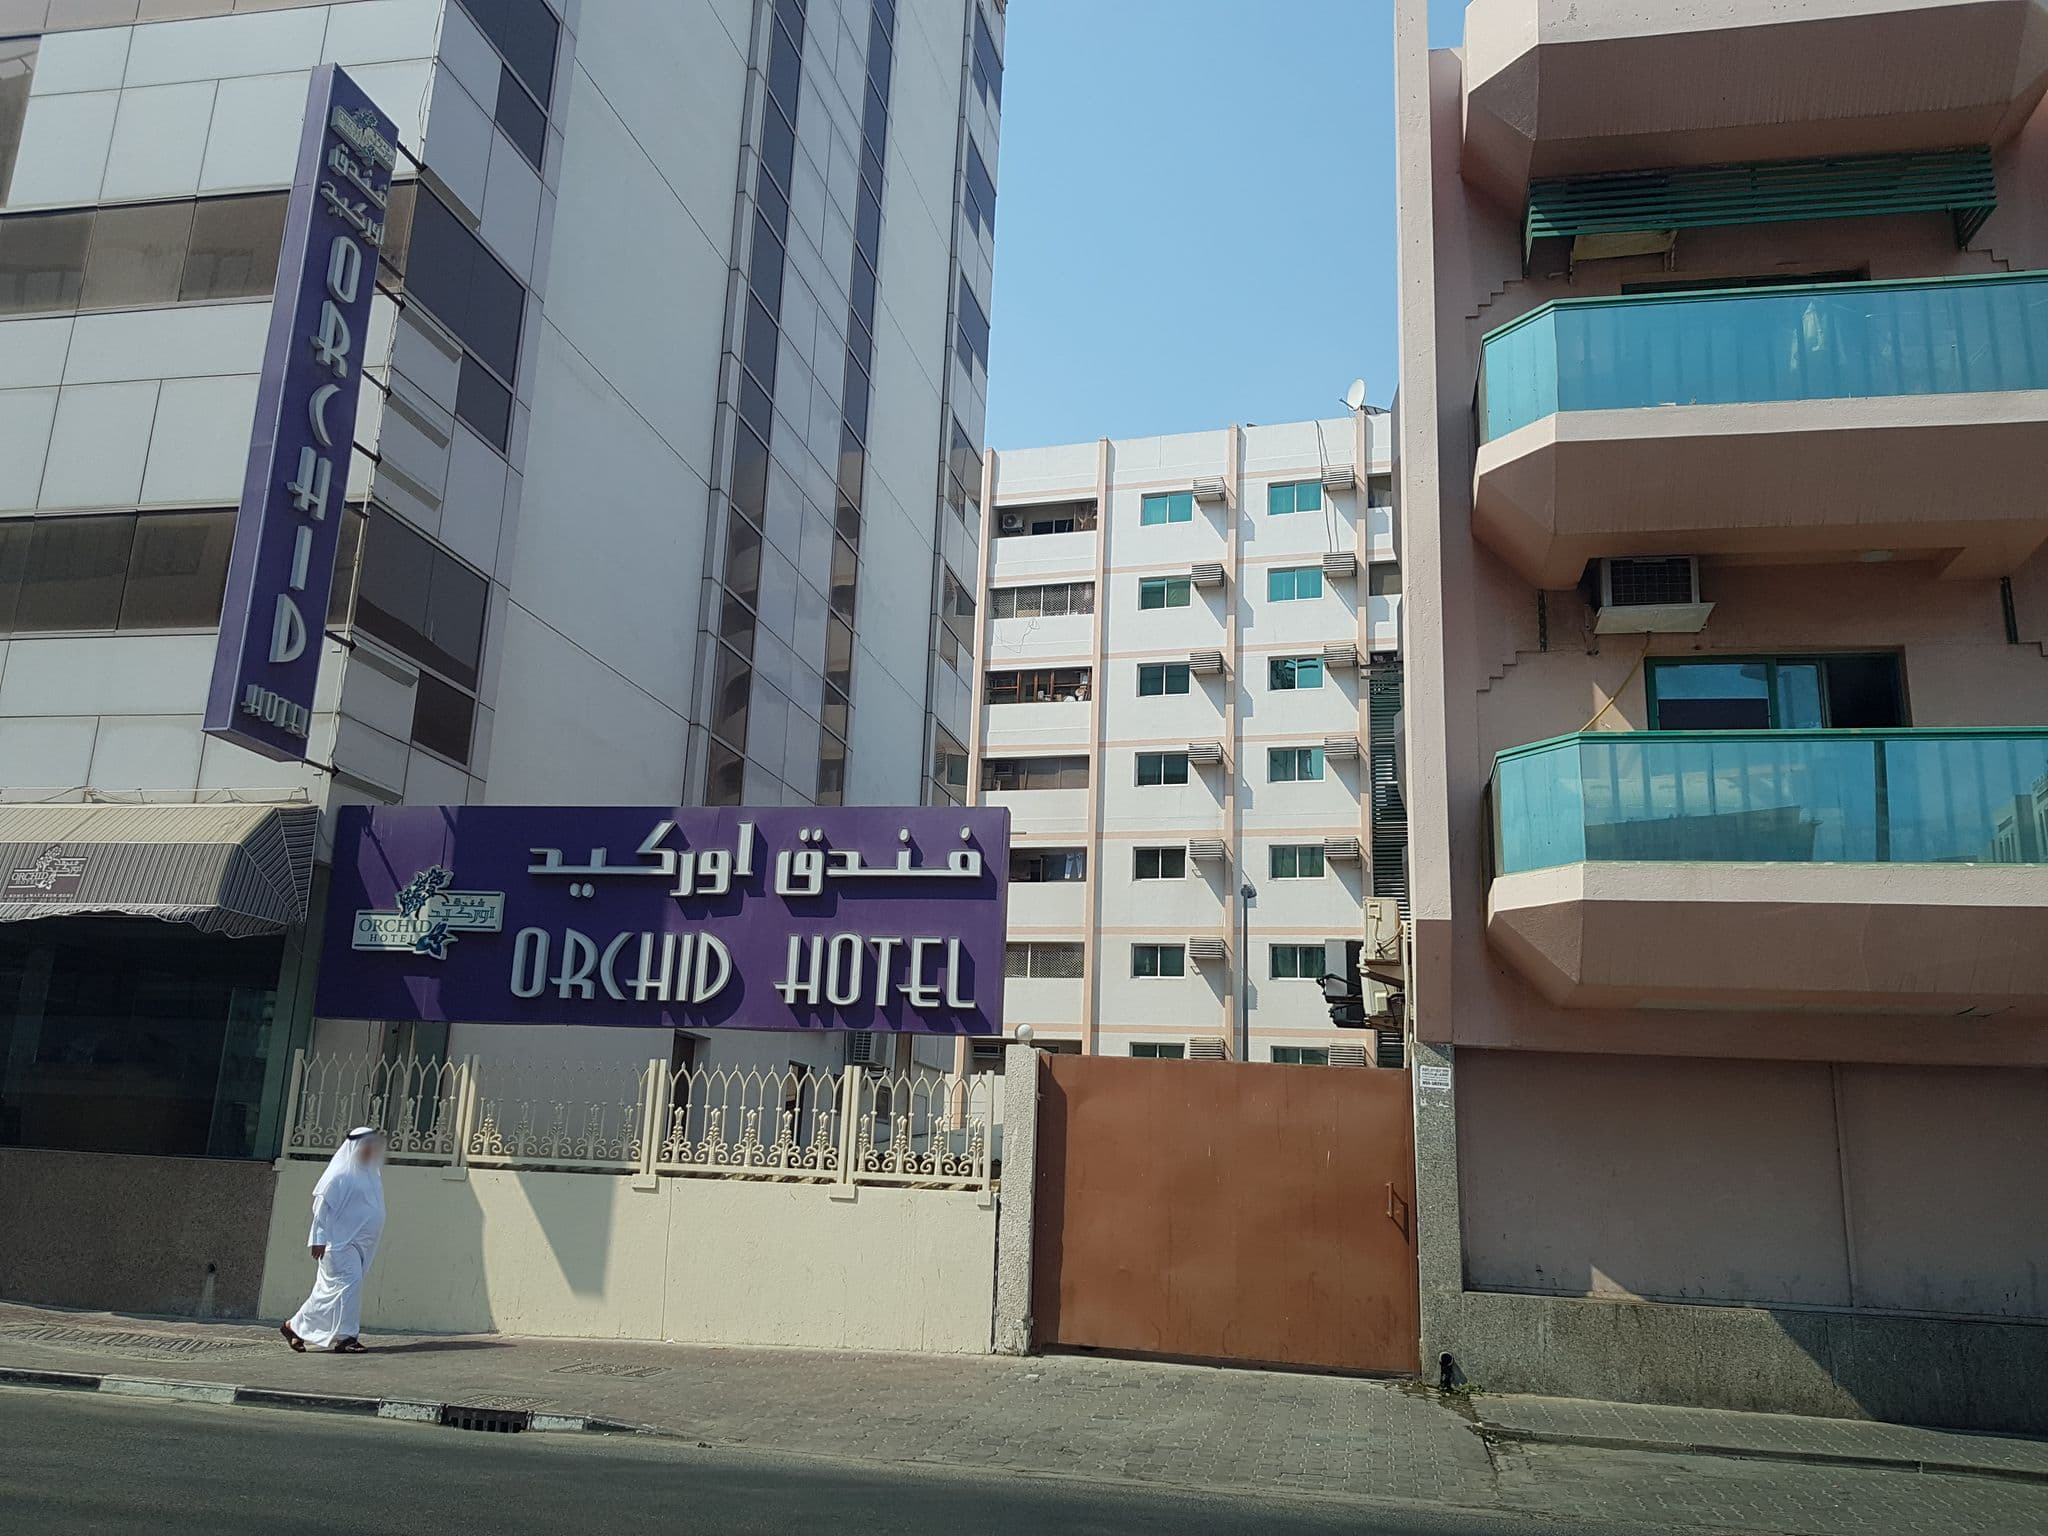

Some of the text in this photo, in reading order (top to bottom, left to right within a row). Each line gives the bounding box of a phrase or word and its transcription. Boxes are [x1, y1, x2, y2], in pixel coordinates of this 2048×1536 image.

[329, 143, 387, 209] فندق
[269, 235, 362, 664] ORCHID
[240, 684, 309, 739] HOTEL
[11, 871, 49, 881] ORCHID
[527, 819, 982, 897] فندق اوركيد
[358, 918, 433, 933] ORCHID
[369, 933, 418, 943] HOTEL
[510, 926, 976, 1008] ORCHID HOTEL
